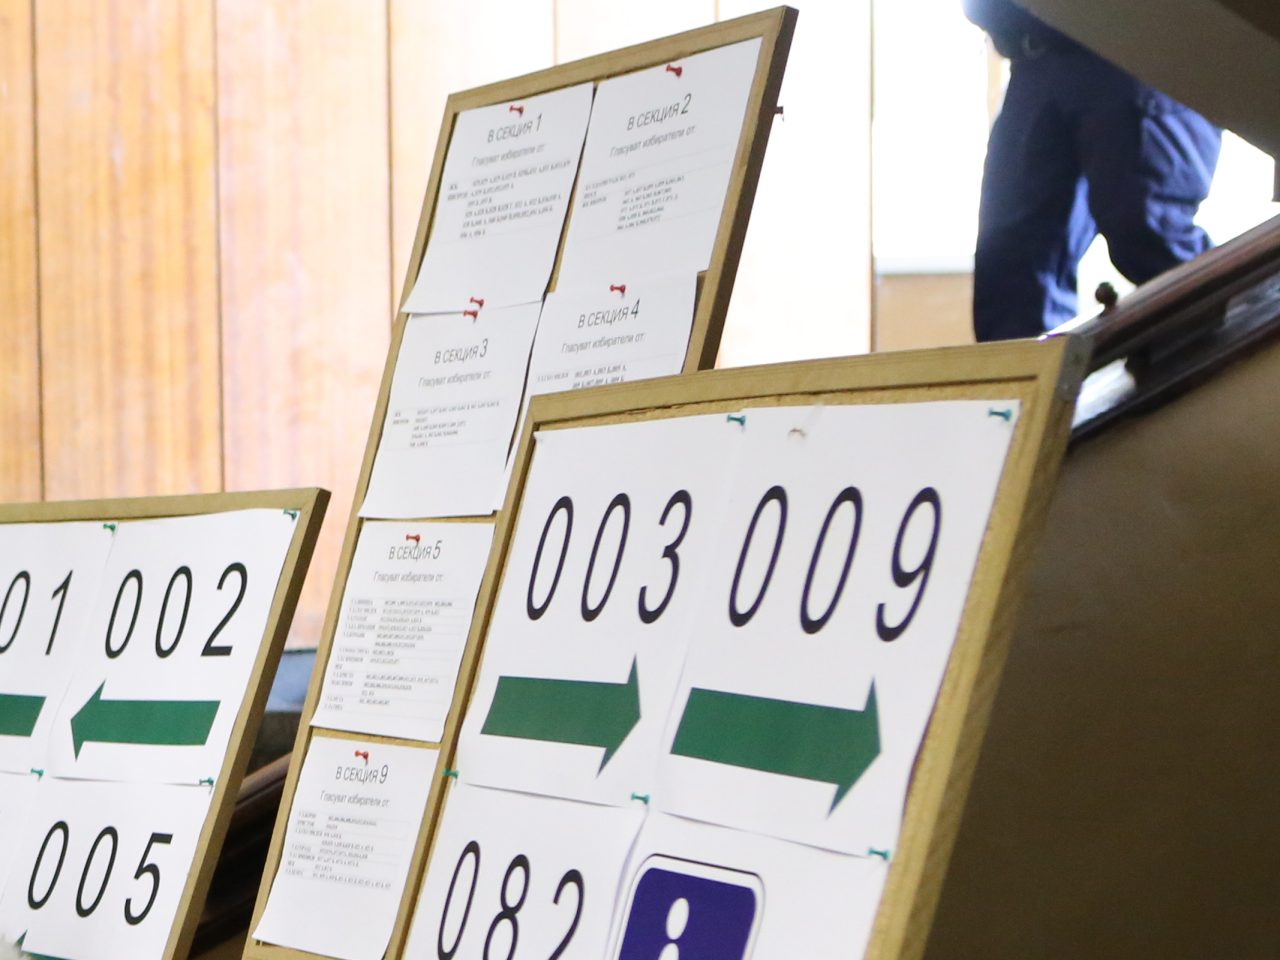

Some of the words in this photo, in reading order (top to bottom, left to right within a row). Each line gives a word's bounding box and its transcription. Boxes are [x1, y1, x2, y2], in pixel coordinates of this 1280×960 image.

[626, 116, 634, 131] В
[636, 102, 680, 128] СЕКЦИЯ
[680, 93, 692, 114] 2
[488, 130, 494, 143] В
[496, 120, 533, 142] СЕКЦИЯ
[536, 113, 543, 132] 1
[609, 141, 641, 158] Гласуват
[642, 130, 684, 148] избиратели
[578, 314, 585, 328] В
[588, 306, 629, 327] СЕКЦИЯ
[630, 299, 640, 319] 4
[434, 351, 441, 364] В
[442, 345, 479, 364] СЕКЦИЯ
[480, 338, 488, 358] 3
[562, 342, 592, 354] Гласуват
[592, 335, 634, 349] избиратели
[418, 375, 446, 388] Гласуват
[447, 371, 482, 384] избиратели
[389, 547, 395, 560] В
[396, 547, 432, 562] СЕКЦИЯ
[433, 540, 442, 559] 5
[526, 489, 693, 625] 003
[728, 485, 943, 643] 009
[104, 562, 249, 659] 002
[336, 766, 342, 780] В
[344, 767, 378, 784] СЕКЦИЯ
[380, 765, 388, 784] 9
[27, 820, 174, 926] 005
